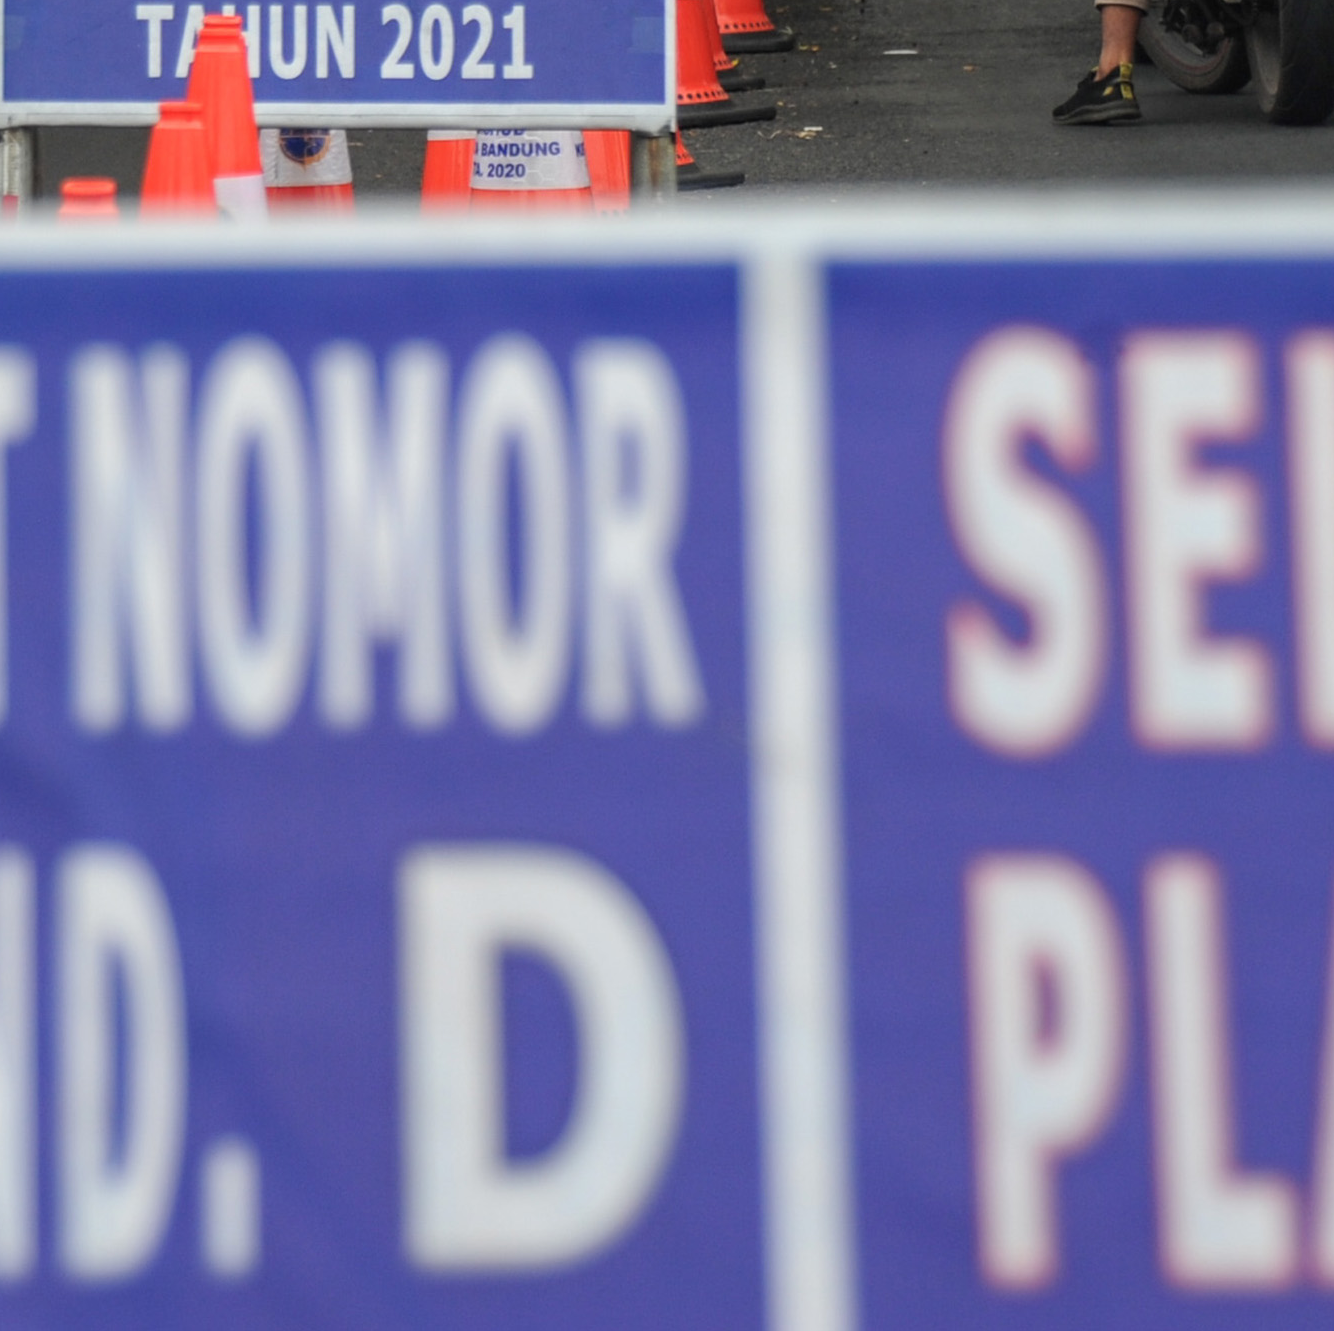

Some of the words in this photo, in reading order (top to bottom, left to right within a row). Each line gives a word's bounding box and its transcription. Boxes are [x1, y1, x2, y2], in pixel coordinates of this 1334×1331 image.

[136, 2, 355, 81] TAHUN
[380, 2, 534, 81] 2021
[481, 141, 561, 157] BANDUNG
[487, 163, 526, 178] 2020
[72, 334, 702, 737] NOMOR
[402, 844, 683, 1271] D
